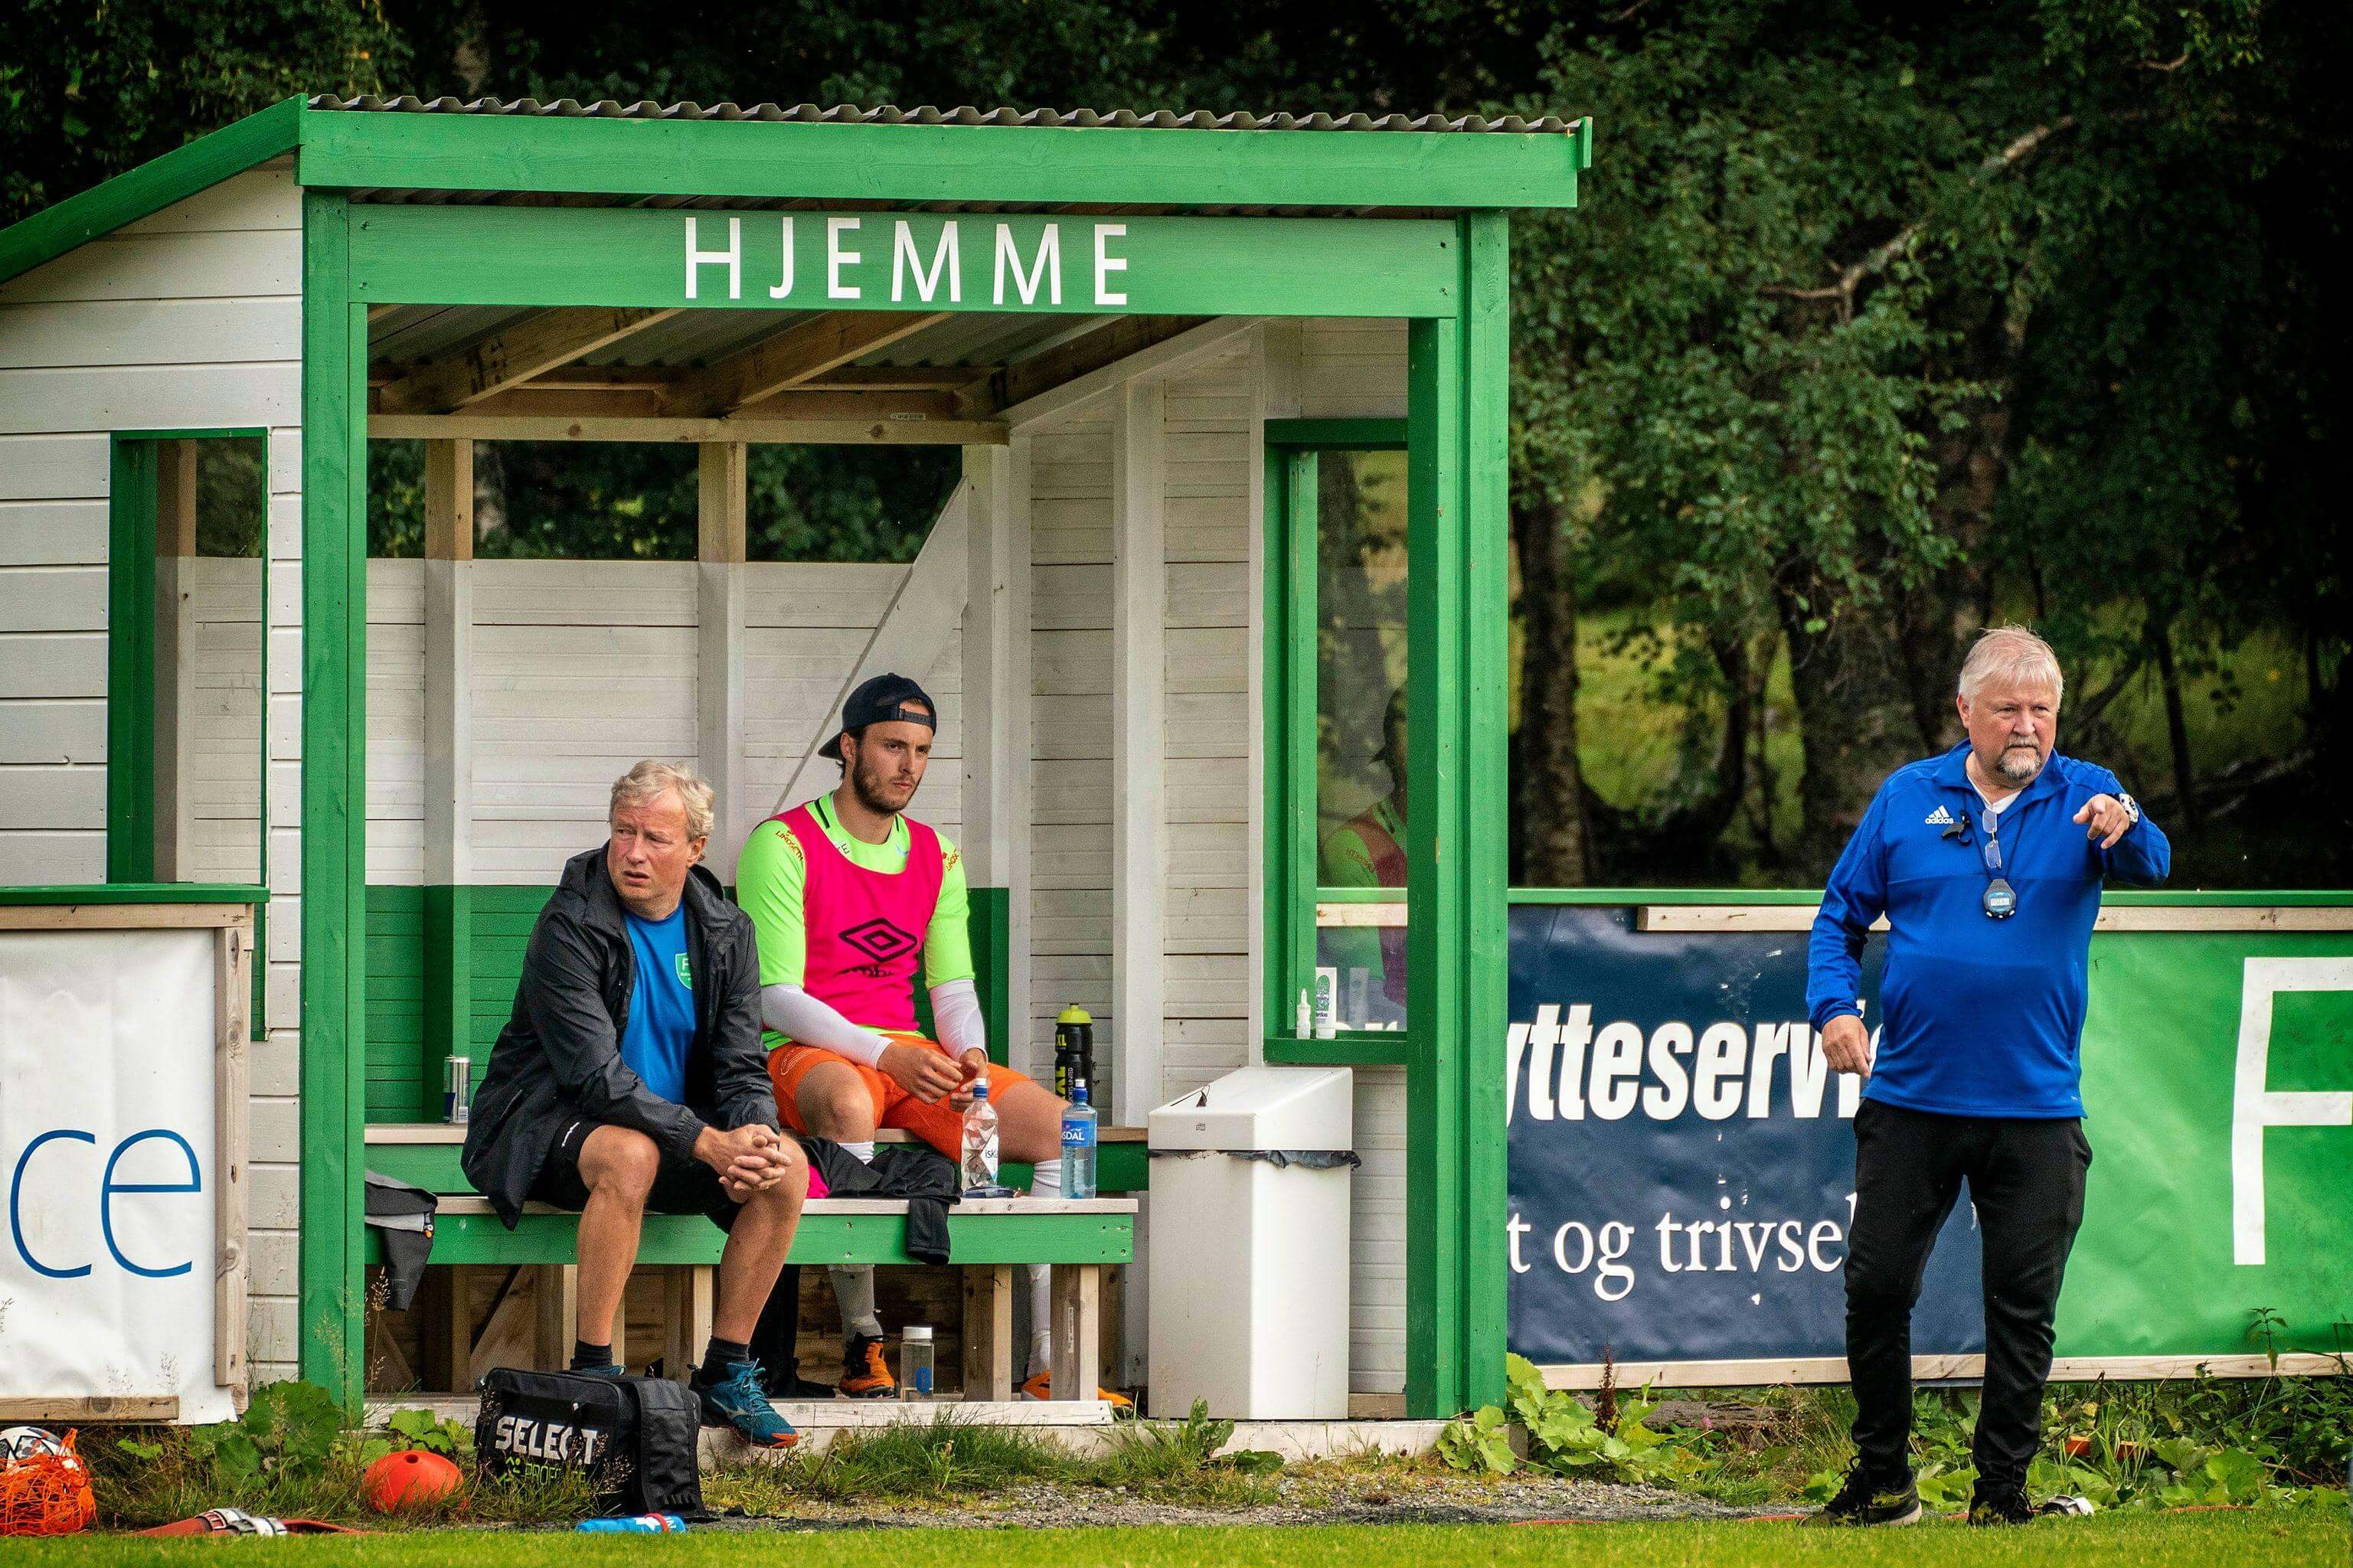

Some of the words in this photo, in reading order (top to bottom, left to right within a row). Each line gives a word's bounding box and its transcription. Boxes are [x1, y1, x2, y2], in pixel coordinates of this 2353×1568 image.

[685, 217, 1127, 305] HJEMME
[1507, 1004, 1884, 1129] ytteserv
[2231, 956, 2353, 1265] F
[10, 1129, 201, 1278] ce
[1553, 1220, 1635, 1302] og
[1655, 1191, 1857, 1274] trivse
[495, 1415, 599, 1465] SELECT
